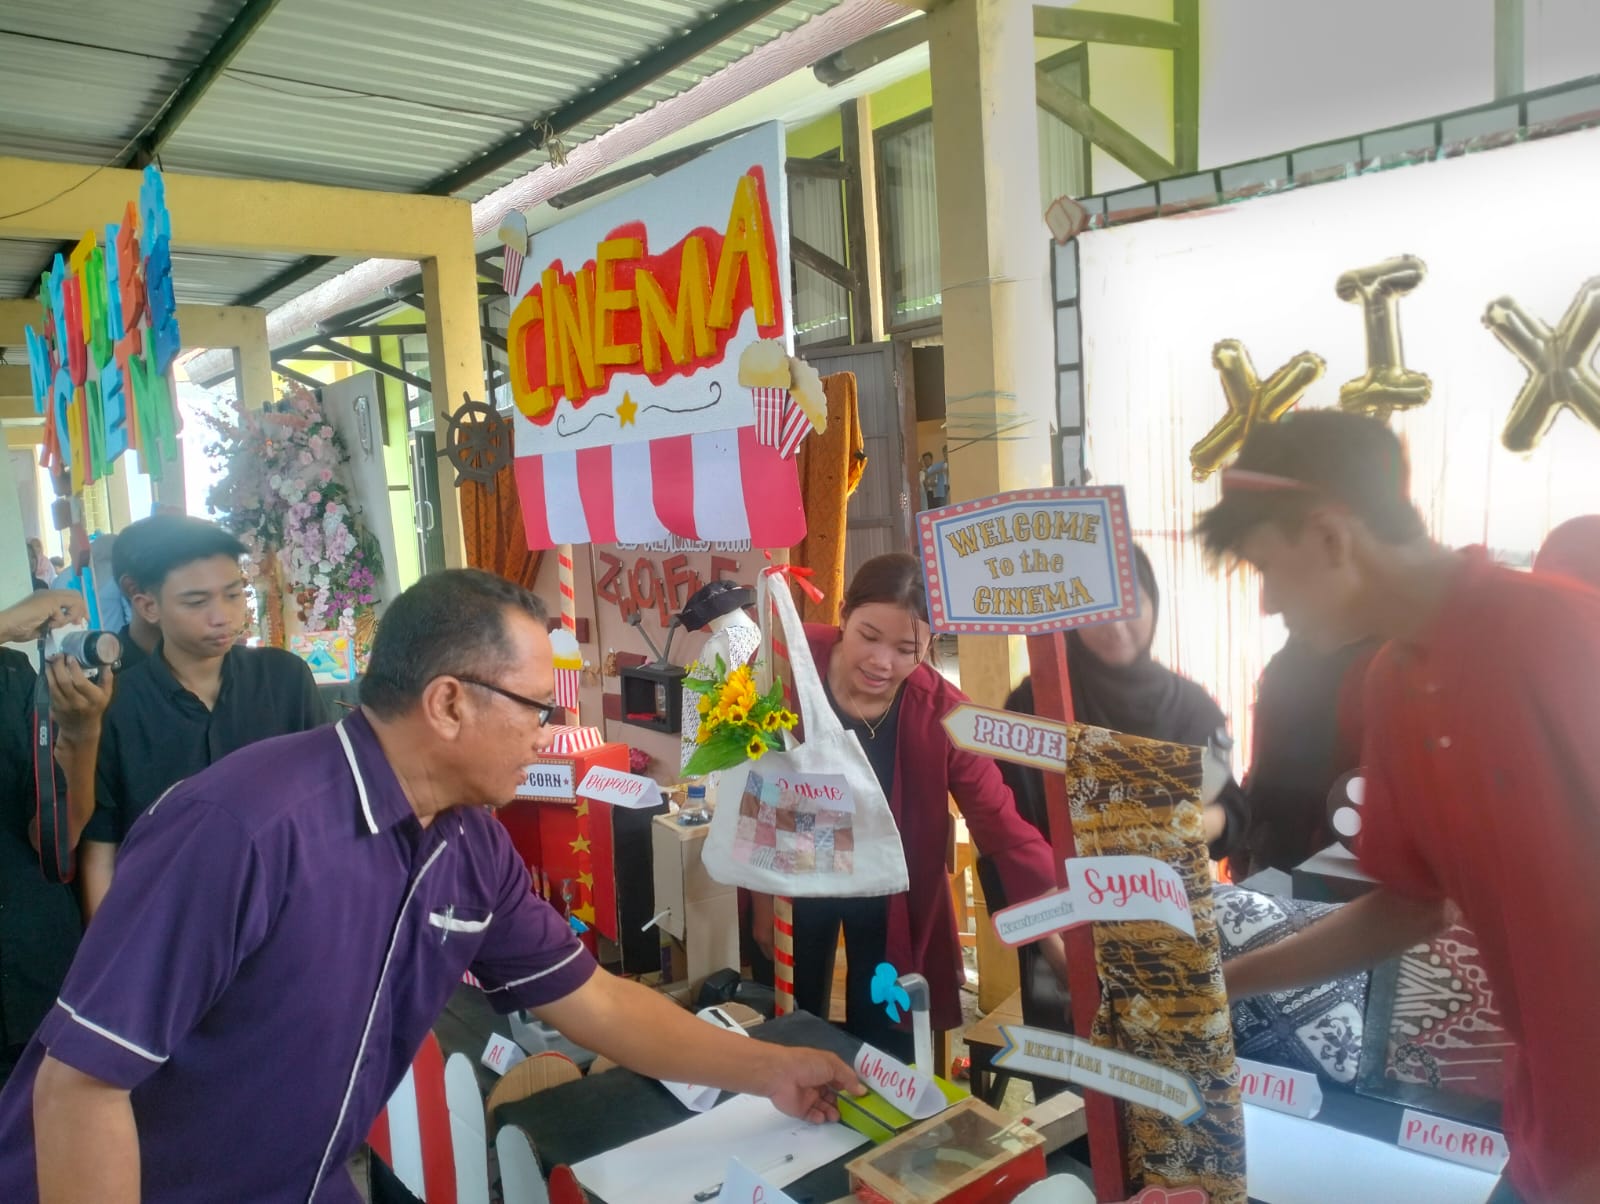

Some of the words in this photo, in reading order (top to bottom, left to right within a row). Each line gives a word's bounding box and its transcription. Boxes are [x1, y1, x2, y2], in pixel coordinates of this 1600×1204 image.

[507, 175, 775, 418] CINEMA
[946, 510, 1100, 557] WELCOME
[1019, 548, 1064, 574] the
[972, 576, 1094, 616] CINEMA
[859, 1052, 916, 1102] Whoosh
[1236, 1063, 1297, 1106] NTAL
